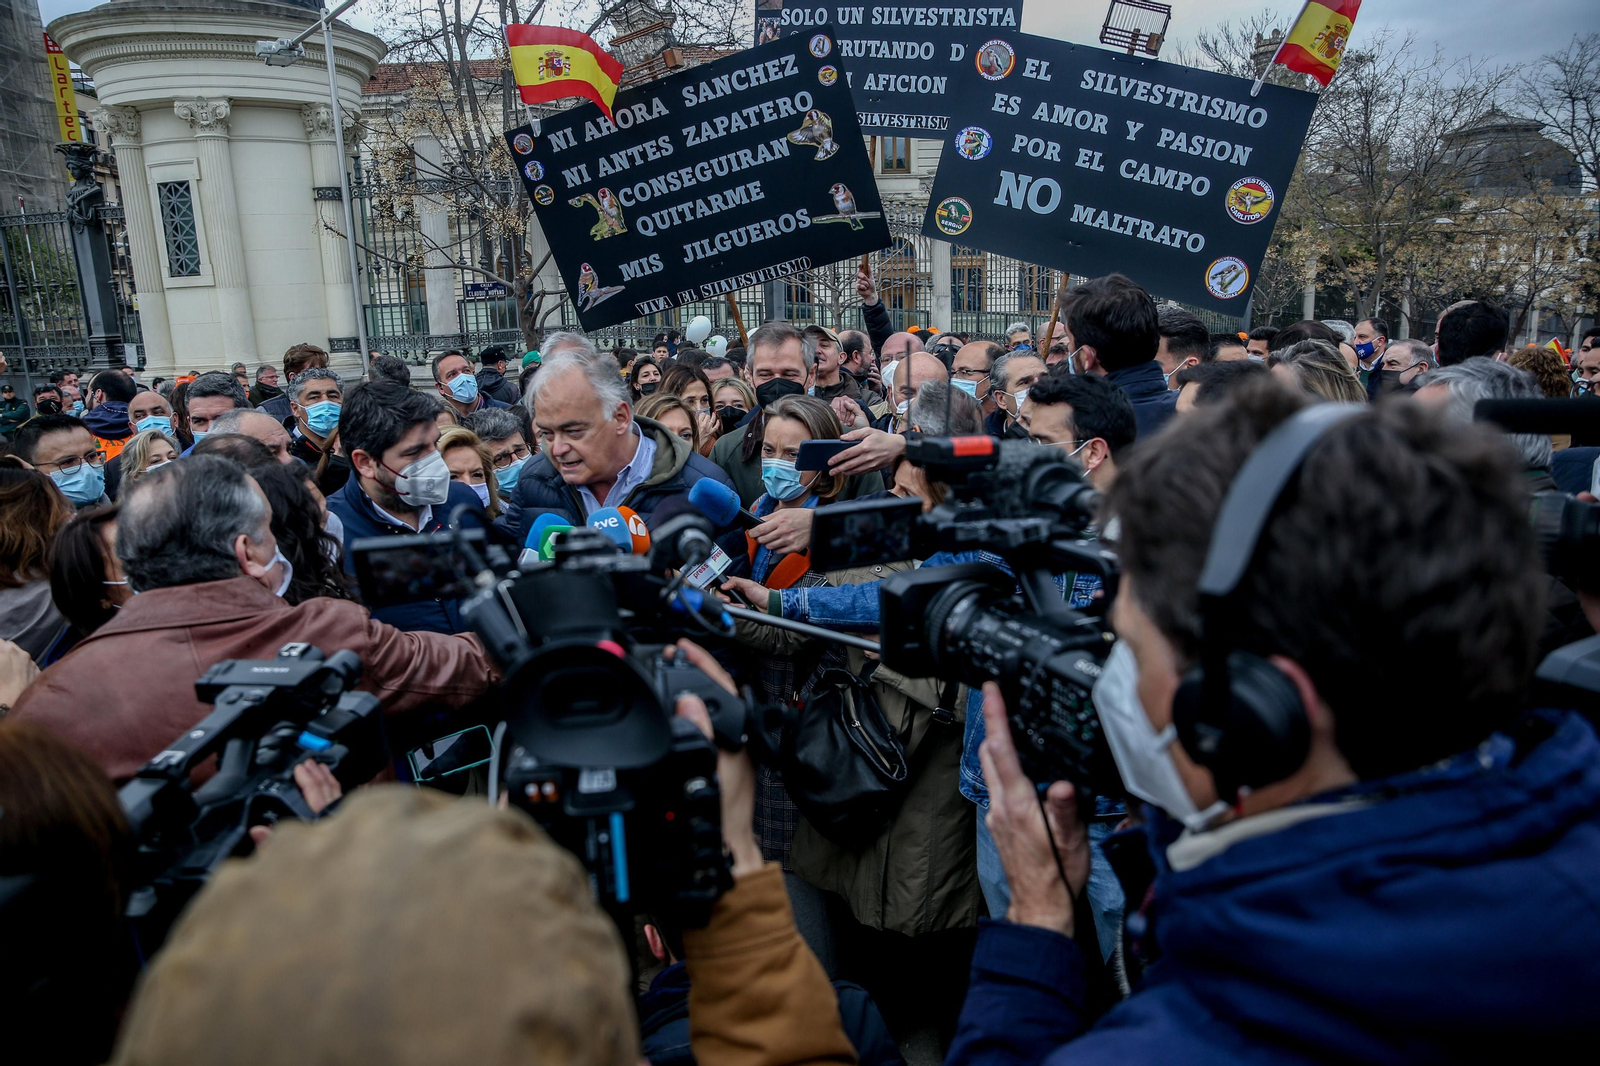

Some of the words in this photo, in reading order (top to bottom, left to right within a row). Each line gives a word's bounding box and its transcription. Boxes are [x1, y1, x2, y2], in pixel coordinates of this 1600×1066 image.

[780, 7, 828, 26] SOLO
[837, 6, 865, 25] UN
[871, 6, 1017, 27] SILVESTRISTA
[837, 39, 935, 61] RUTANDO
[949, 43, 969, 62] D
[547, 126, 578, 153] NI
[584, 96, 670, 143] AHORA
[681, 54, 799, 108] SANCHEZ
[863, 73, 948, 95] AFICION
[1022, 57, 1053, 82] EL
[1079, 69, 1268, 129] SILVESTRISMO
[561, 163, 592, 189] NI
[598, 135, 674, 178] ANTES
[681, 91, 814, 148] ZAPATERO
[991, 92, 1022, 117] ES
[1031, 101, 1109, 135] AMOR
[1125, 120, 1145, 142] Y
[1156, 128, 1253, 167] PASION
[618, 136, 791, 207] CONSEGUIRAN
[1011, 133, 1062, 163] POR
[1074, 147, 1106, 173] EL
[1119, 158, 1211, 197] CAMPO
[1233, 178, 1272, 200] SILVESTRISMO
[635, 180, 766, 237] QUITARME
[993, 170, 1062, 216] NO
[1070, 203, 1206, 254] MALTRATO
[1230, 205, 1261, 221] CARLITOS
[618, 253, 664, 282] MIS
[682, 208, 812, 264] JILGUEROS
[635, 295, 673, 316] VIVA
[677, 288, 699, 306] EL
[700, 255, 812, 299] SILVESTRISMO
[593, 516, 619, 530] tve
[692, 563, 709, 580] press
[711, 549, 724, 563] press
